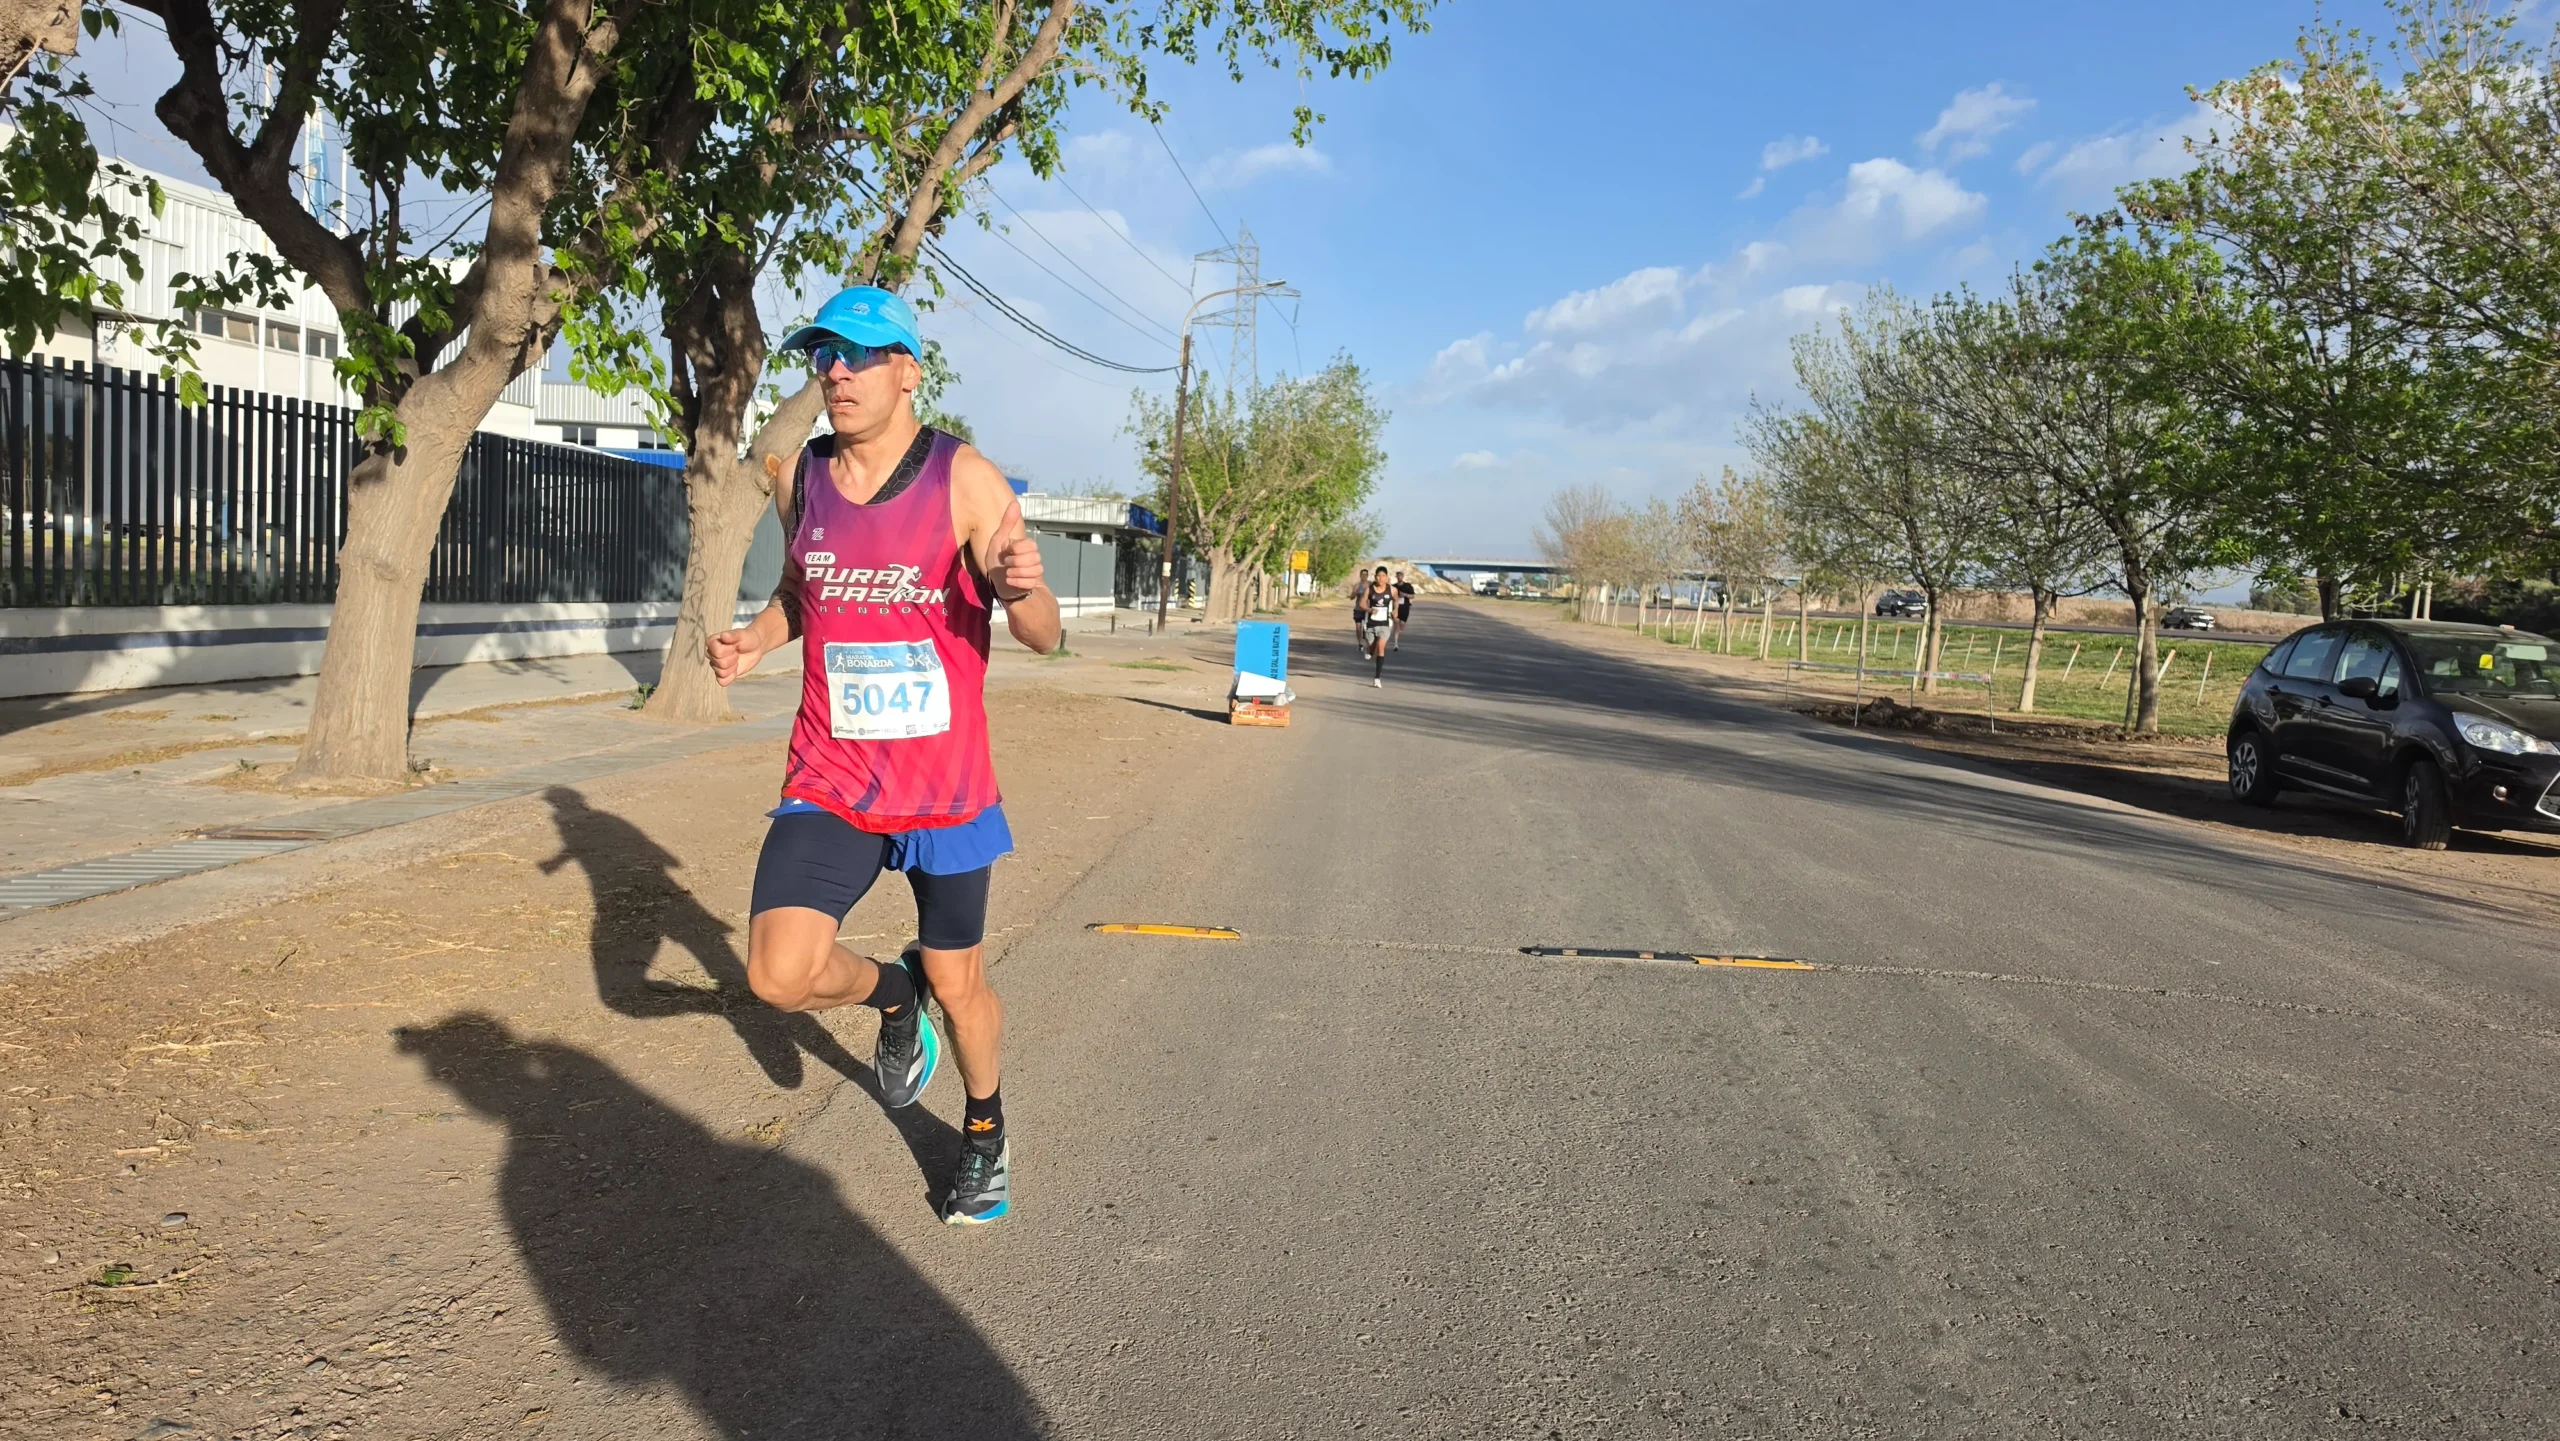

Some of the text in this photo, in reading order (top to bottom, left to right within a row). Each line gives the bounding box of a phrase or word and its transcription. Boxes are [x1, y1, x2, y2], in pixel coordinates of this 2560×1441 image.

[807, 554, 832, 562] TEAM
[805, 567, 902, 585] PURA
[819, 606, 949, 616] MENDOZA
[847, 658, 895, 668] BONARDA
[905, 652, 926, 667] 5K
[843, 681, 934, 716] 5047
